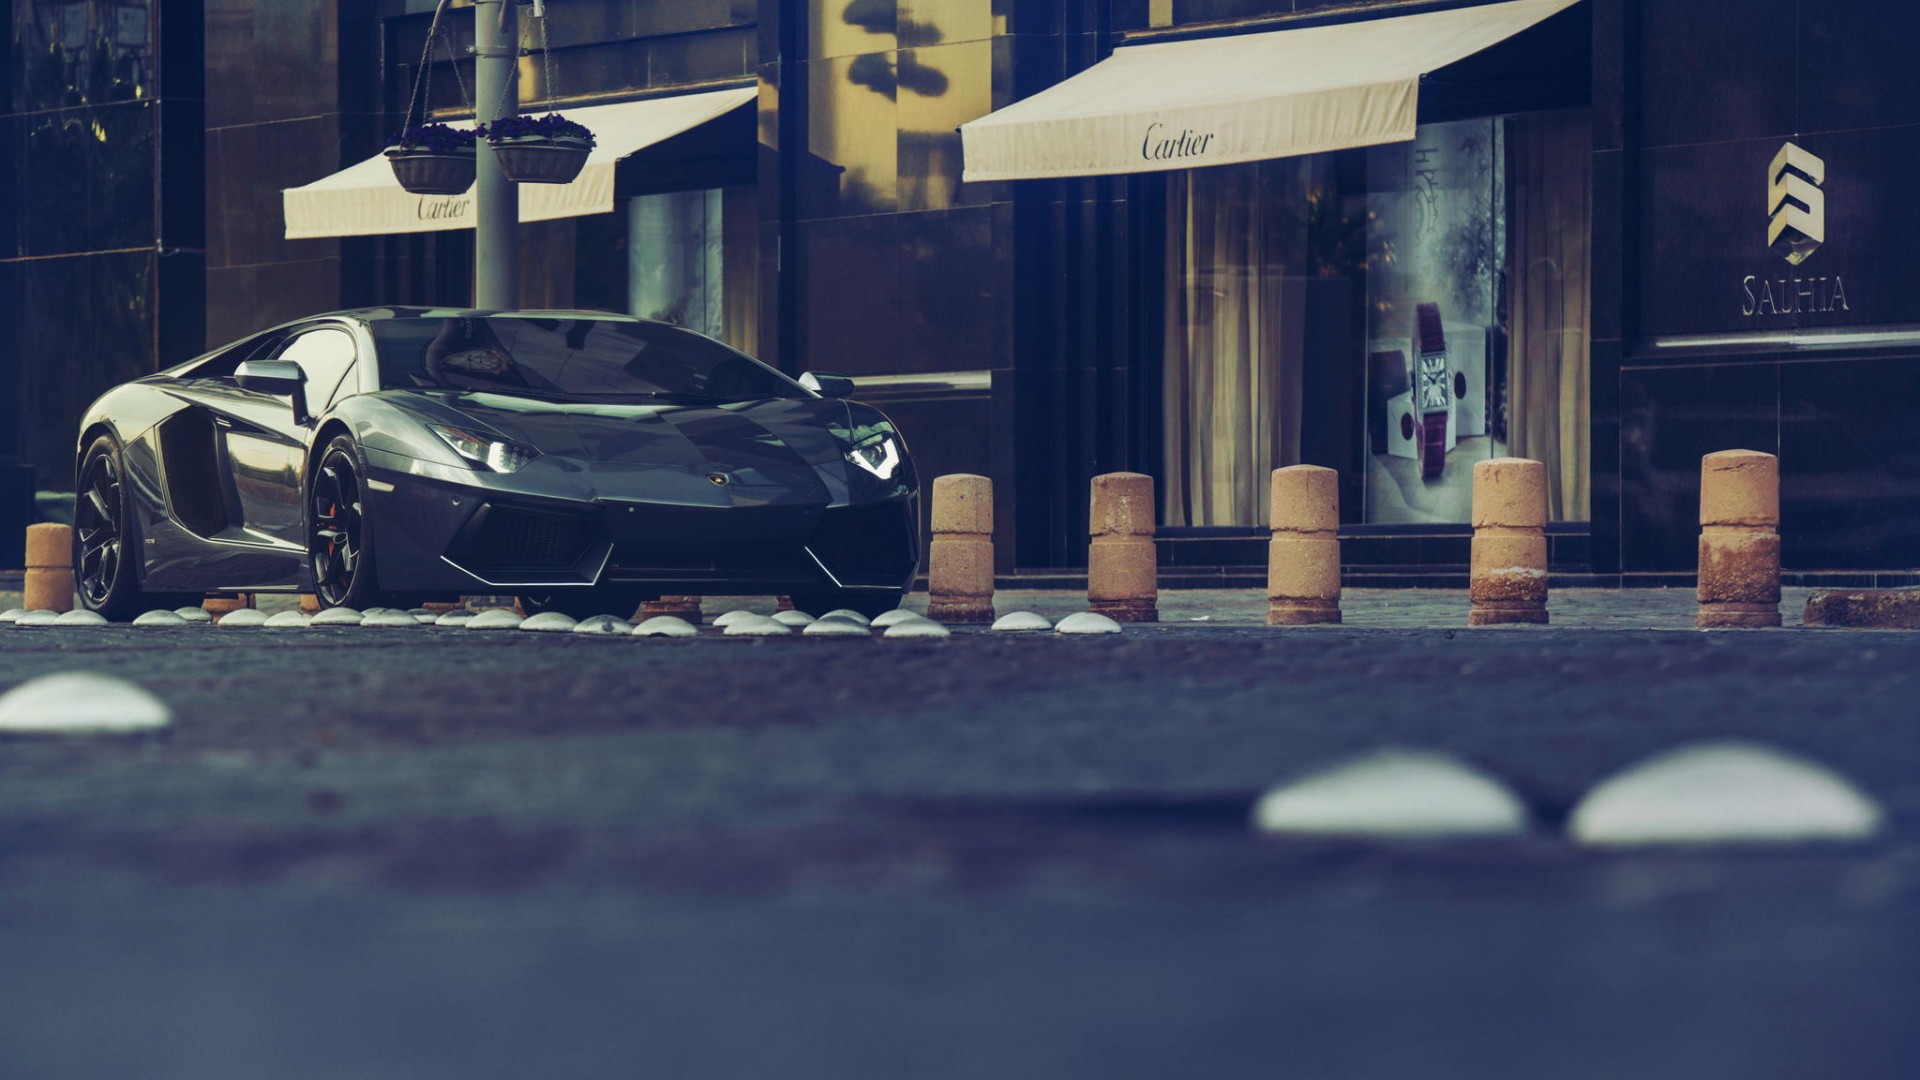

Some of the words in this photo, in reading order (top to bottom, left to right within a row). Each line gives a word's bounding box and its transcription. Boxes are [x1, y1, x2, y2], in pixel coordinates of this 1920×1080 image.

[1142, 122, 1214, 160] Cartier
[417, 193, 470, 220] Cartier
[1742, 275, 1850, 316] SALHIA
